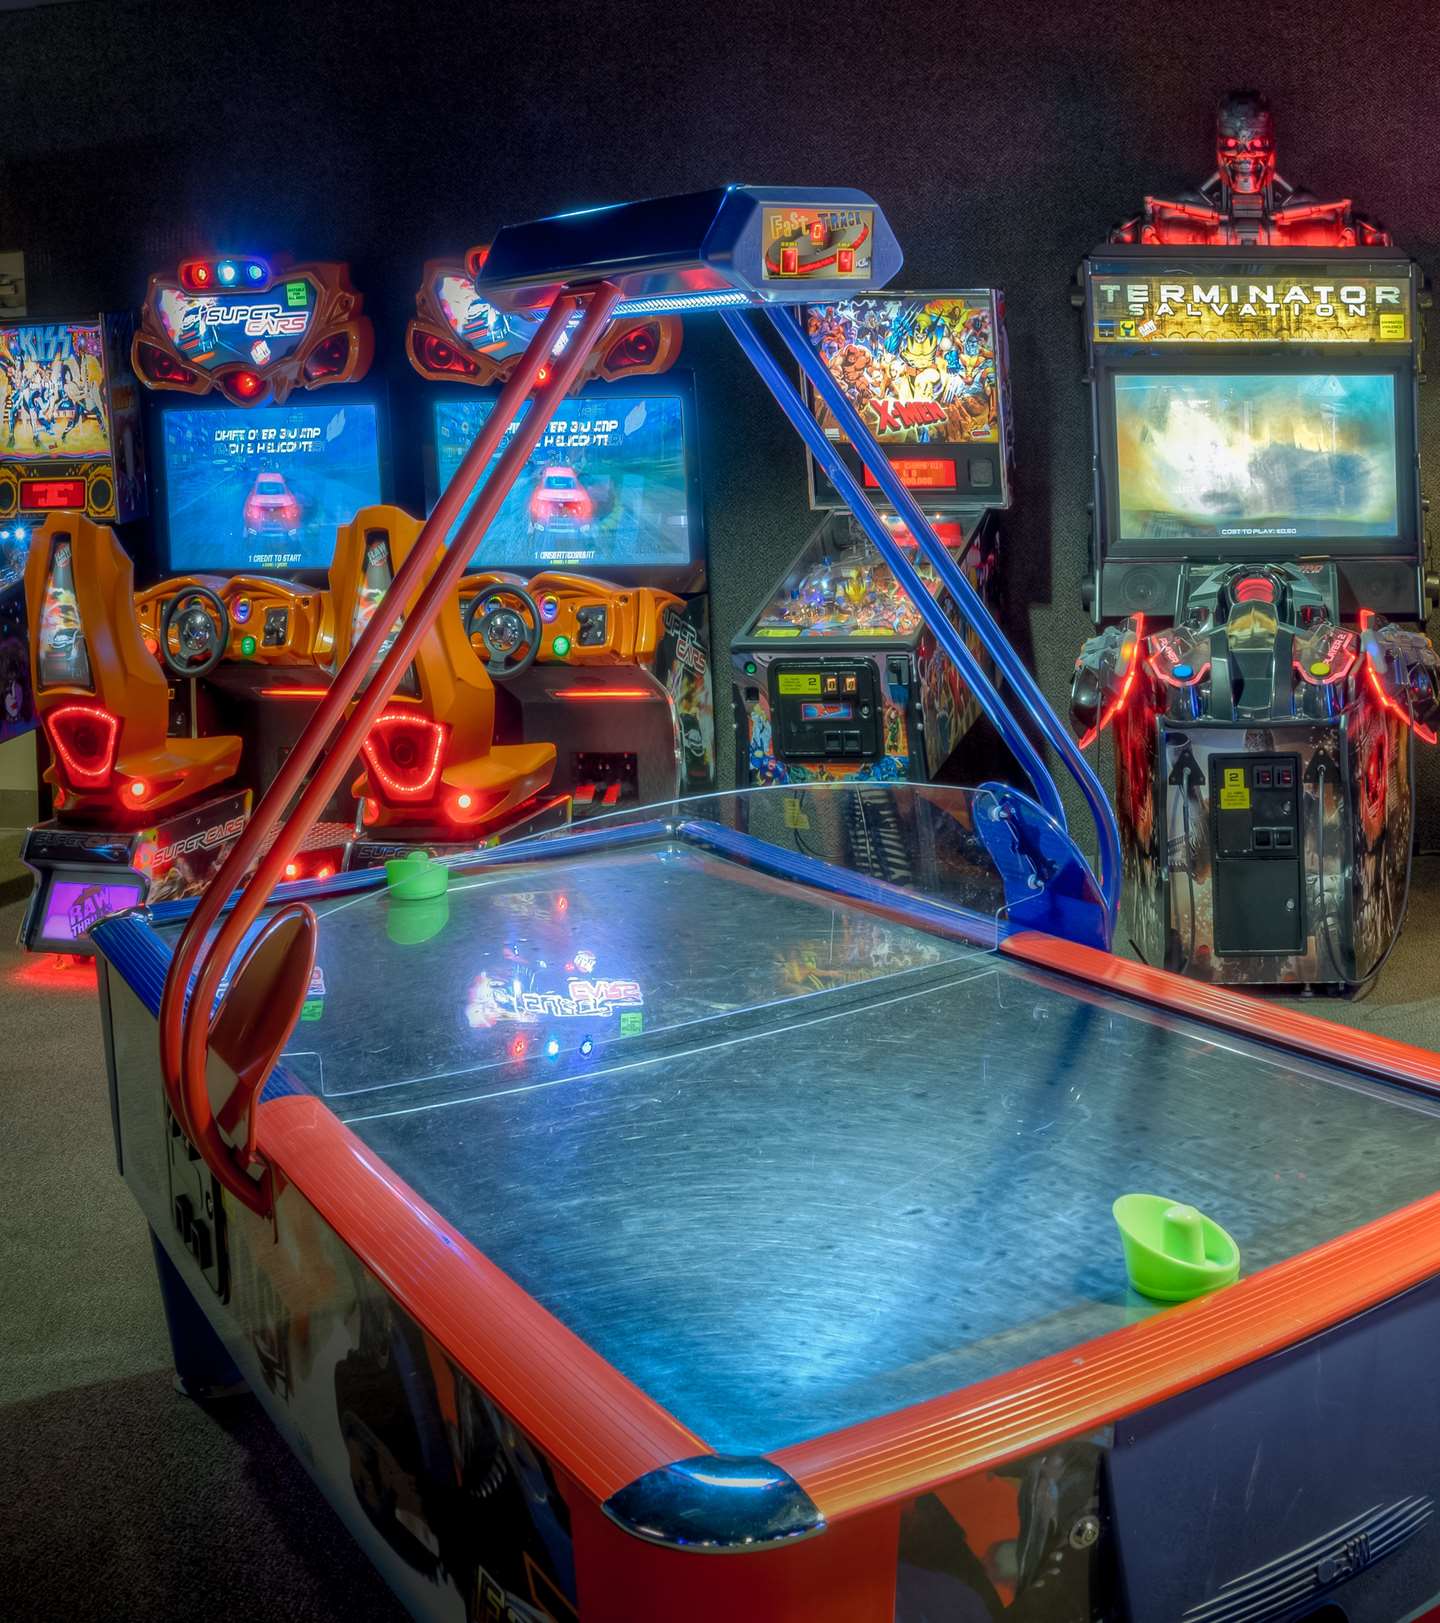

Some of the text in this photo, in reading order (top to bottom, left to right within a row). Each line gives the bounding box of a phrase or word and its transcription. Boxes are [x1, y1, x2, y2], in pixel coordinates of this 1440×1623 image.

[1100, 284, 1400, 304] TERMINATOR
[1128, 303, 1367, 317] SALVATION
[207, 305, 296, 326] SUPER
[245, 317, 309, 336] CARS
[18, 326, 72, 362] KISS
[869, 399, 947, 433] X-MEN
[664, 608, 704, 650] UPER
[676, 639, 707, 675] CARS
[152, 816, 245, 868] SUPER CARS
[70, 886, 112, 926] RAW
